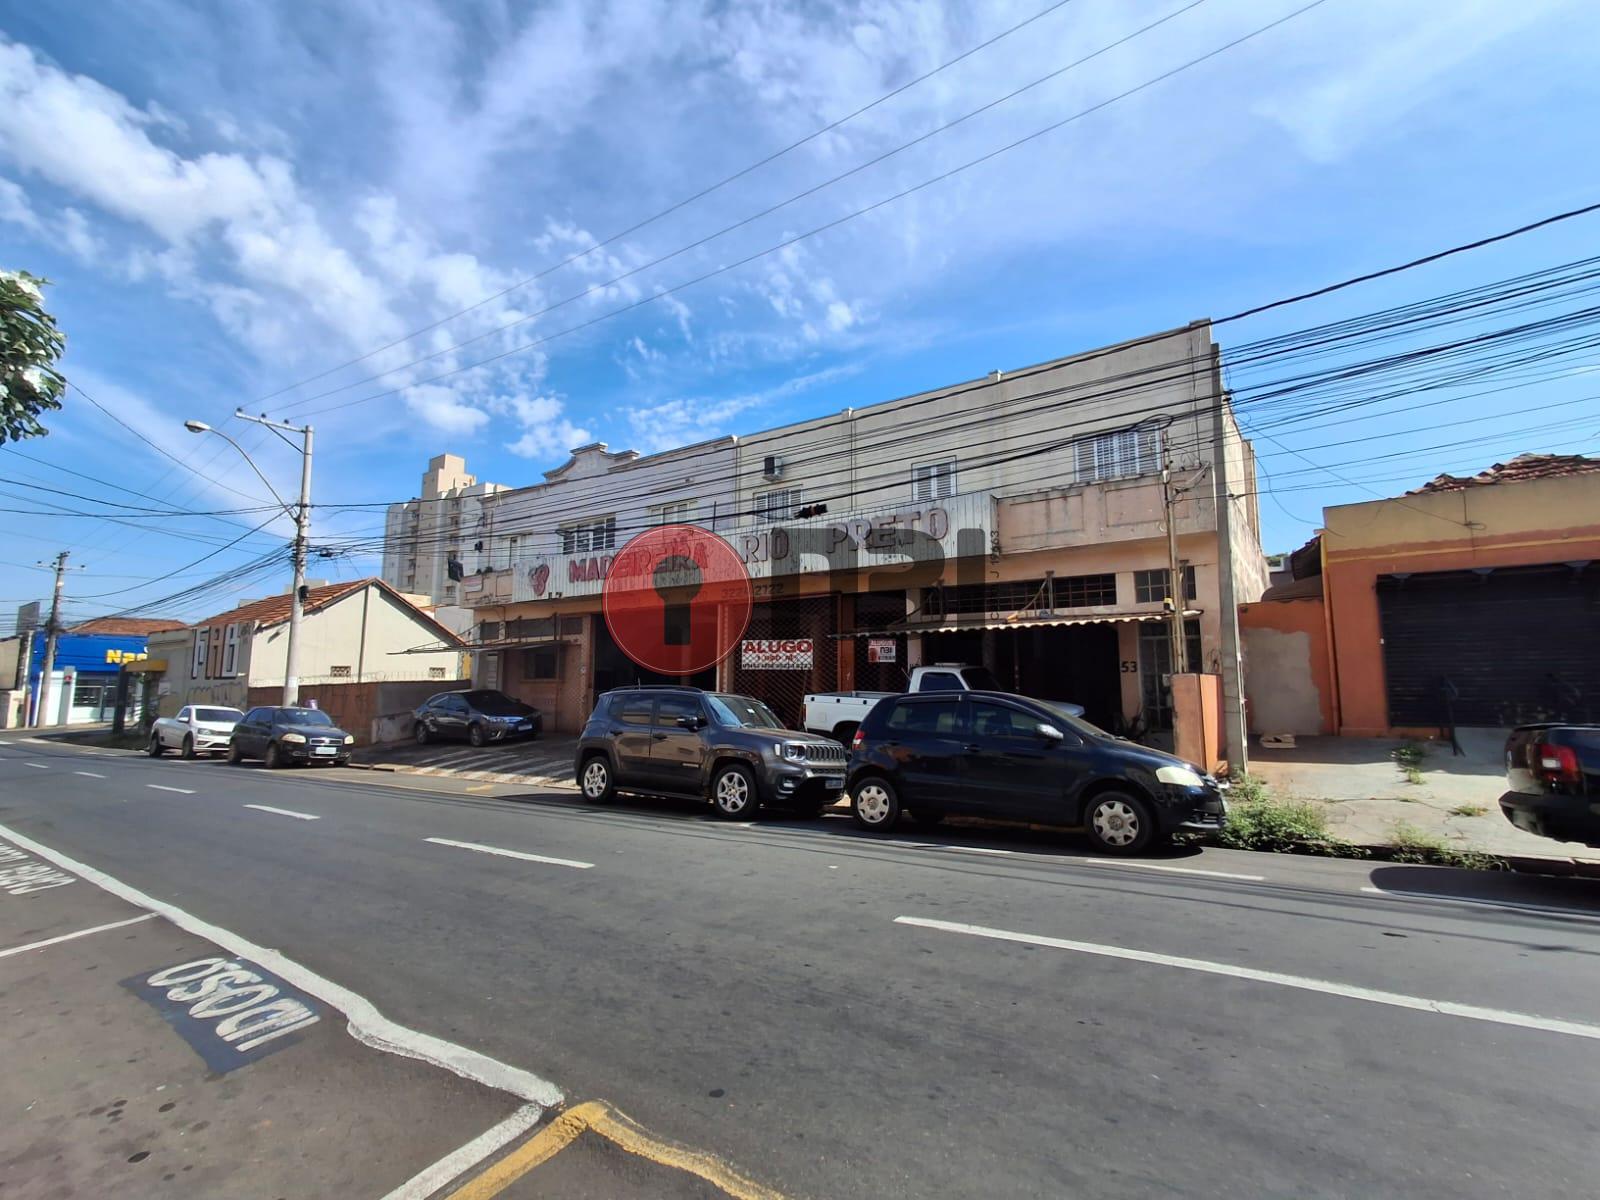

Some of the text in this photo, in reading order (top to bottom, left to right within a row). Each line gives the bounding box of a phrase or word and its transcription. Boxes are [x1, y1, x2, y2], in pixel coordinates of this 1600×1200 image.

[740, 526, 789, 564] RIO
[827, 508, 948, 554] PRETO
[743, 640, 813, 653] ALUGO
[1121, 661, 1137, 672] 53
[147, 958, 320, 1052] IDOSO
